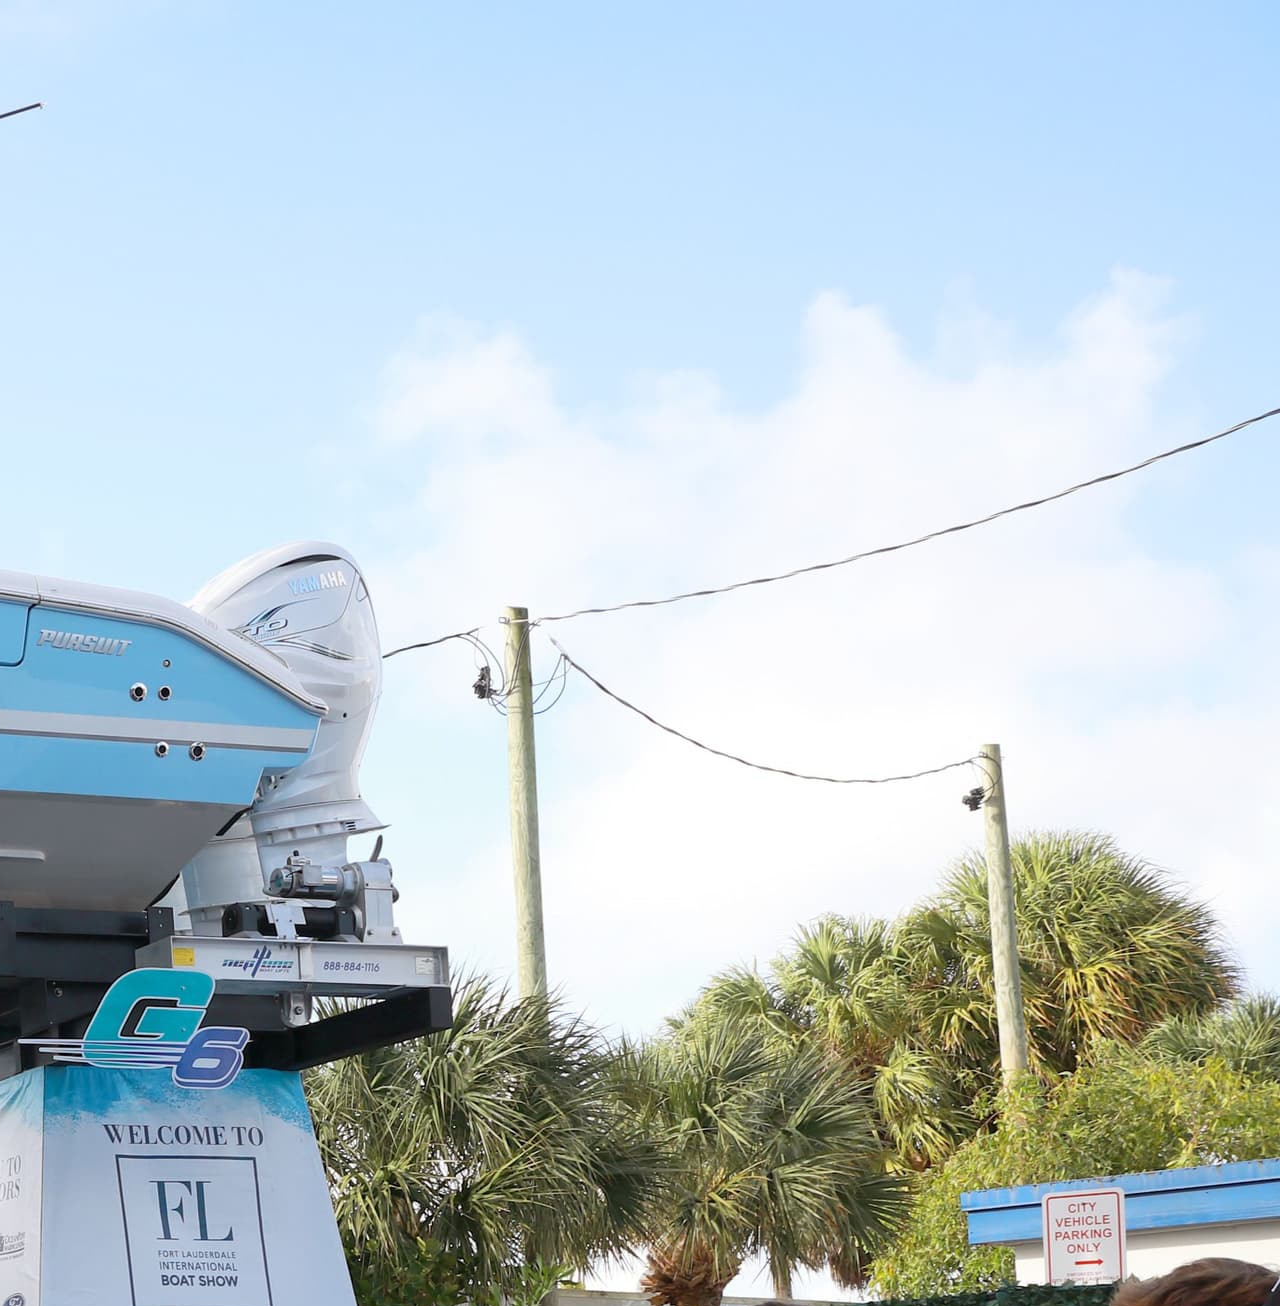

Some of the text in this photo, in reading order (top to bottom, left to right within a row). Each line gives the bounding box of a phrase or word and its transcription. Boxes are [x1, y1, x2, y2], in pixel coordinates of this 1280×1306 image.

[288, 571, 347, 596] YAMAHA
[36, 629, 133, 656] PURSUIT
[323, 960, 380, 973] 888-884-1116
[81, 967, 252, 1090] G6
[102, 1124, 264, 1147] WELCOME TO
[8, 1155, 22, 1177] TO
[148, 1180, 234, 1241] FL
[1068, 1202, 1096, 1213] CITY
[1055, 1214, 1111, 1228] VEHICLE
[1055, 1228, 1112, 1241] PARKING
[158, 1250, 237, 1259] FORT LAUDERDALE
[1067, 1242, 1101, 1254] ONLY
[159, 1261, 238, 1272] INTERNATIONAL
[161, 1274, 238, 1287] BOAT SHOW
